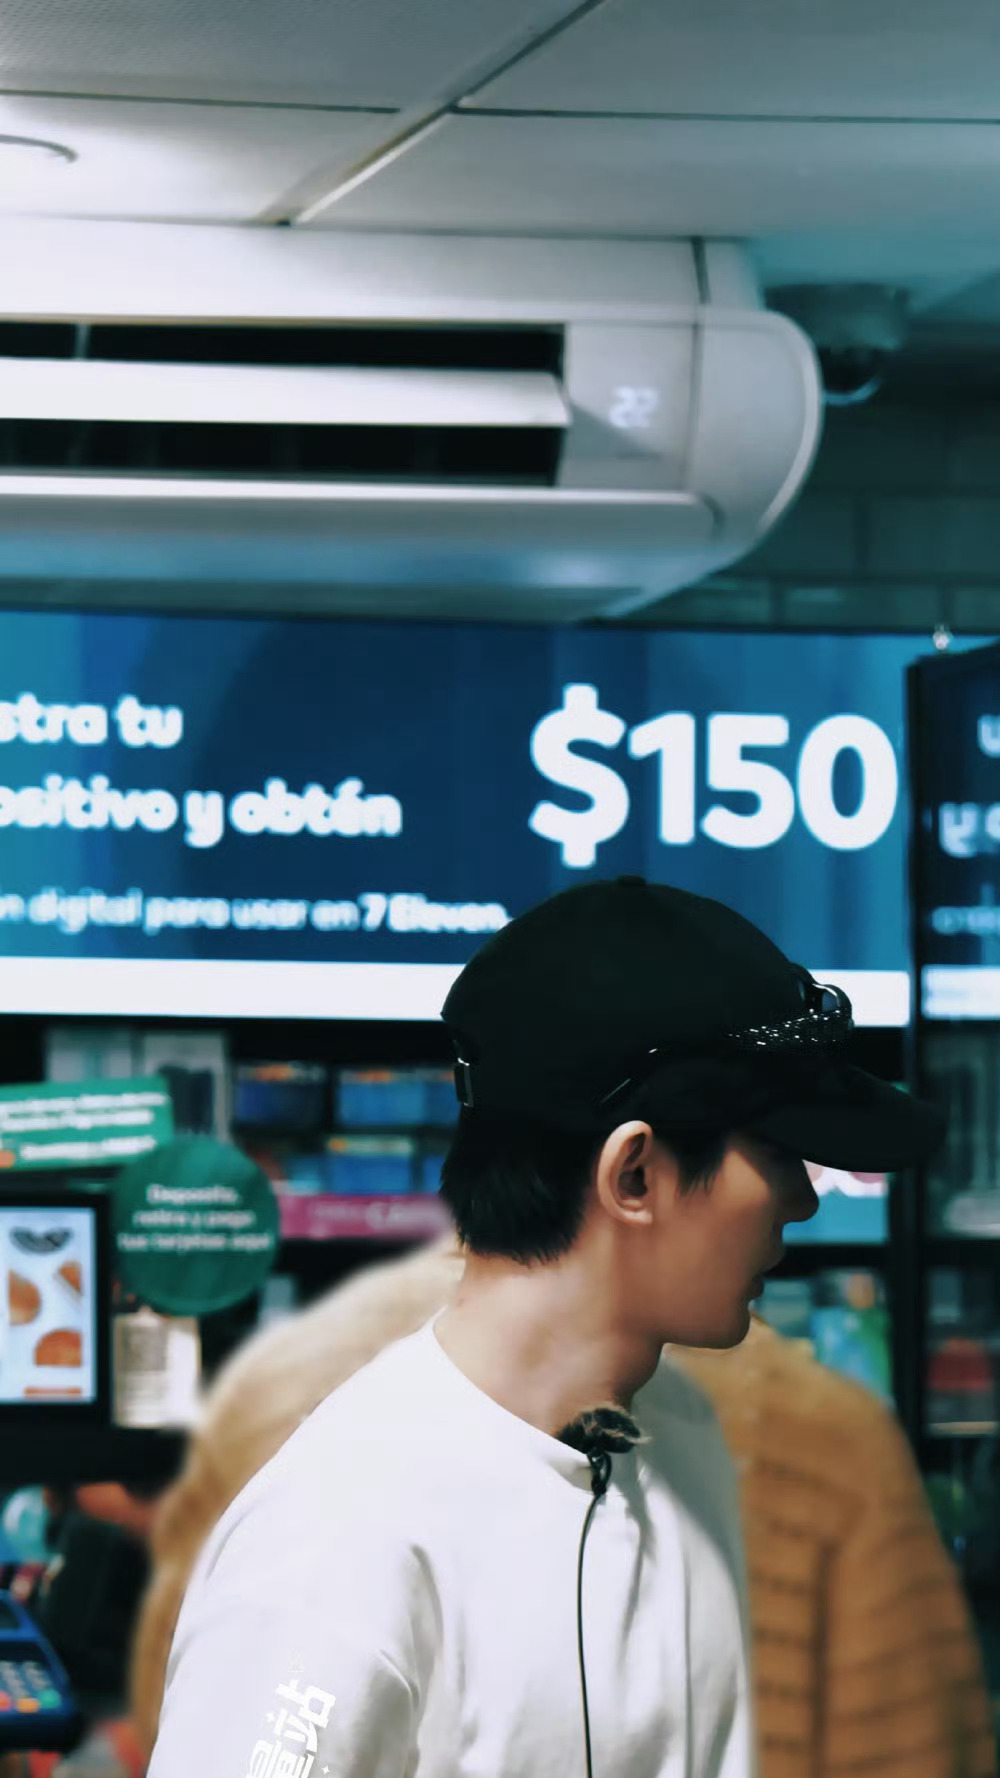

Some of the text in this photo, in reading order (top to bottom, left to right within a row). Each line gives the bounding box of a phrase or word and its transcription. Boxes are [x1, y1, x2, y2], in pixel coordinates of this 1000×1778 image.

[113, 694, 184, 748] tu
[529, 682, 898, 867] $150
[184, 789, 224, 848] y
